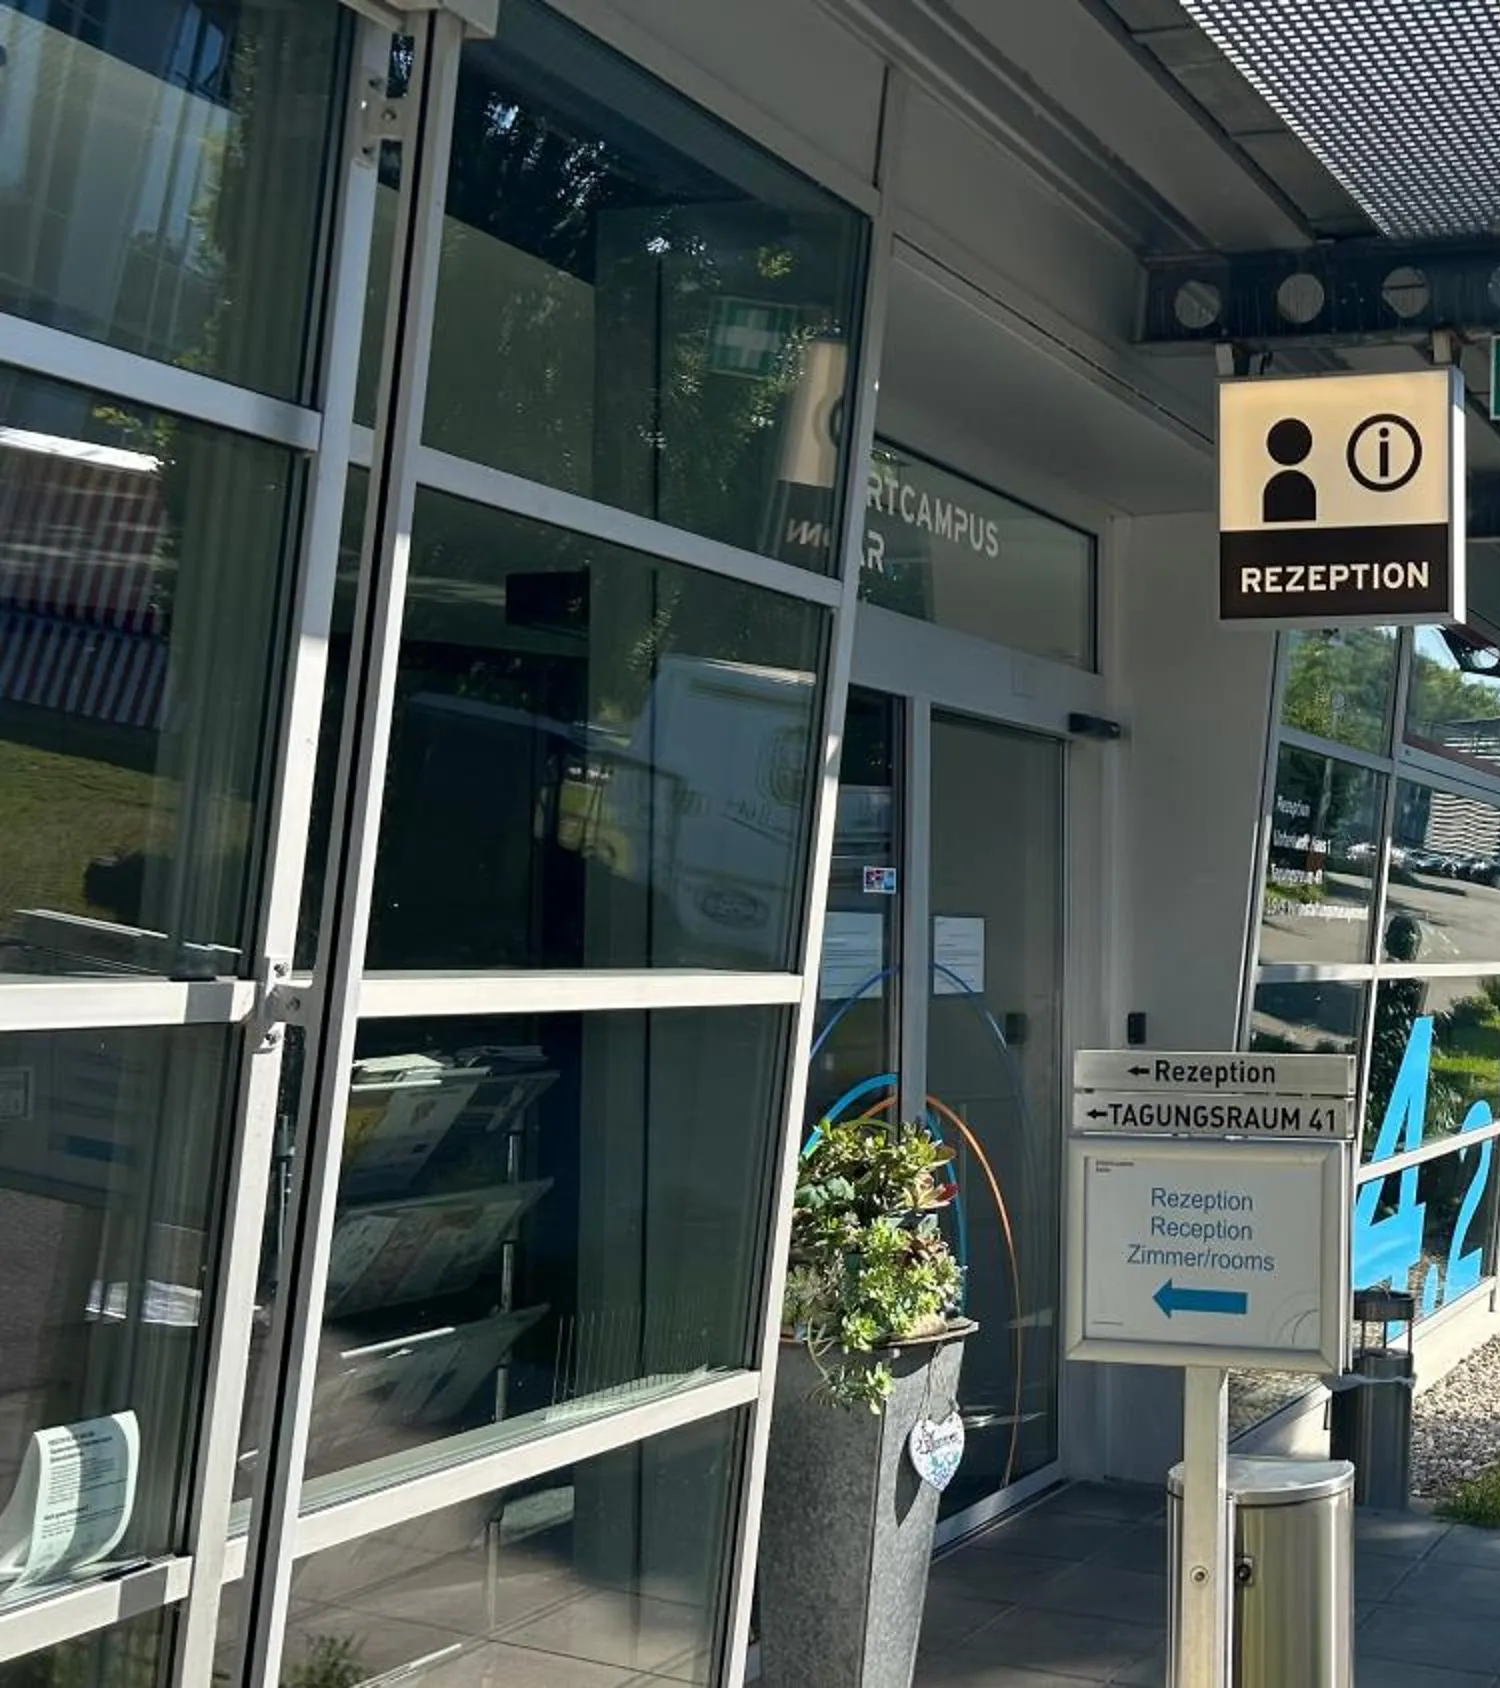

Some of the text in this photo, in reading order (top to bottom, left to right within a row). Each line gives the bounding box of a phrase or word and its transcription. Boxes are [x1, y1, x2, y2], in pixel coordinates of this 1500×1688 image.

[859, 529, 885, 574] R
[1240, 561, 1430, 594] REZEPTION
[1154, 1059, 1276, 1088] Rezeption
[1108, 1103, 1337, 1133] TAGUNGSRAUM 41
[1150, 1186, 1254, 1214] Rezeption
[1150, 1216, 1254, 1243] Reception
[1126, 1243, 1276, 1273] Zimmer/rooms
